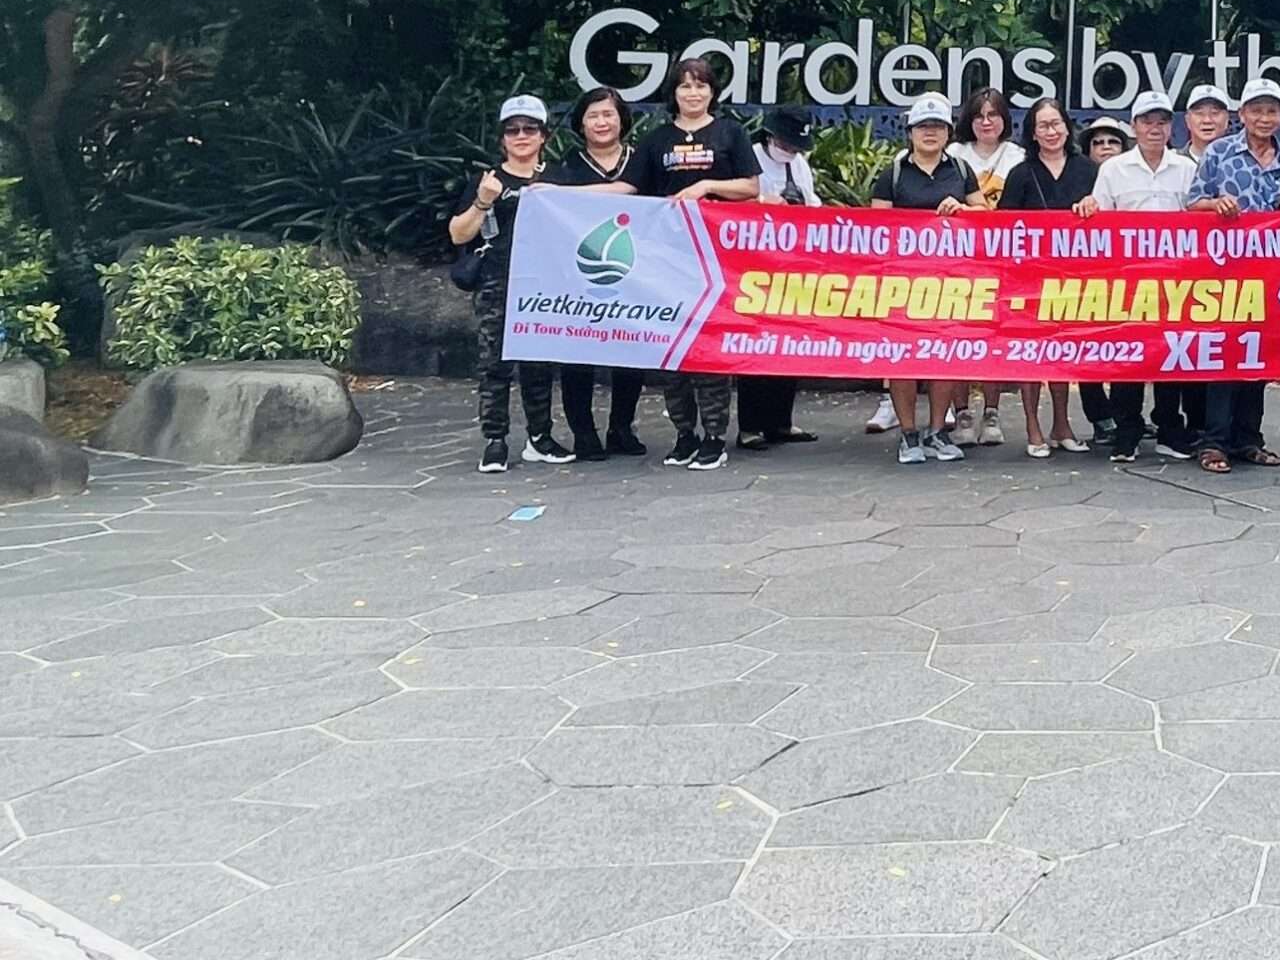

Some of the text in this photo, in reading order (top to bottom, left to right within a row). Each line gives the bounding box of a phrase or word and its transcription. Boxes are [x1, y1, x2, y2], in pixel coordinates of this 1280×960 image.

[569, 7, 1057, 109] Gardens
[1081, 27, 1195, 111] by
[719, 213, 798, 252] CHÀO
[805, 216, 890, 255] MỪNG
[897, 220, 976, 257] ĐOÀN
[983, 219, 1044, 264] VIỆT
[1051, 228, 1112, 258] NAM
[1119, 228, 1198, 258] THAM
[517, 292, 684, 323] vietkingtravel
[734, 270, 1000, 321] SINGAPORE
[1037, 278, 1266, 322] MALAYSIA
[533, 322, 563, 336] Tour
[721, 331, 777, 355] Khởi
[781, 334, 843, 357] hành
[847, 337, 912, 363] ngày:
[915, 339, 988, 362] 24/09
[1006, 340, 1144, 364] 28/09/2022
[1160, 330, 1266, 371] XE 1
